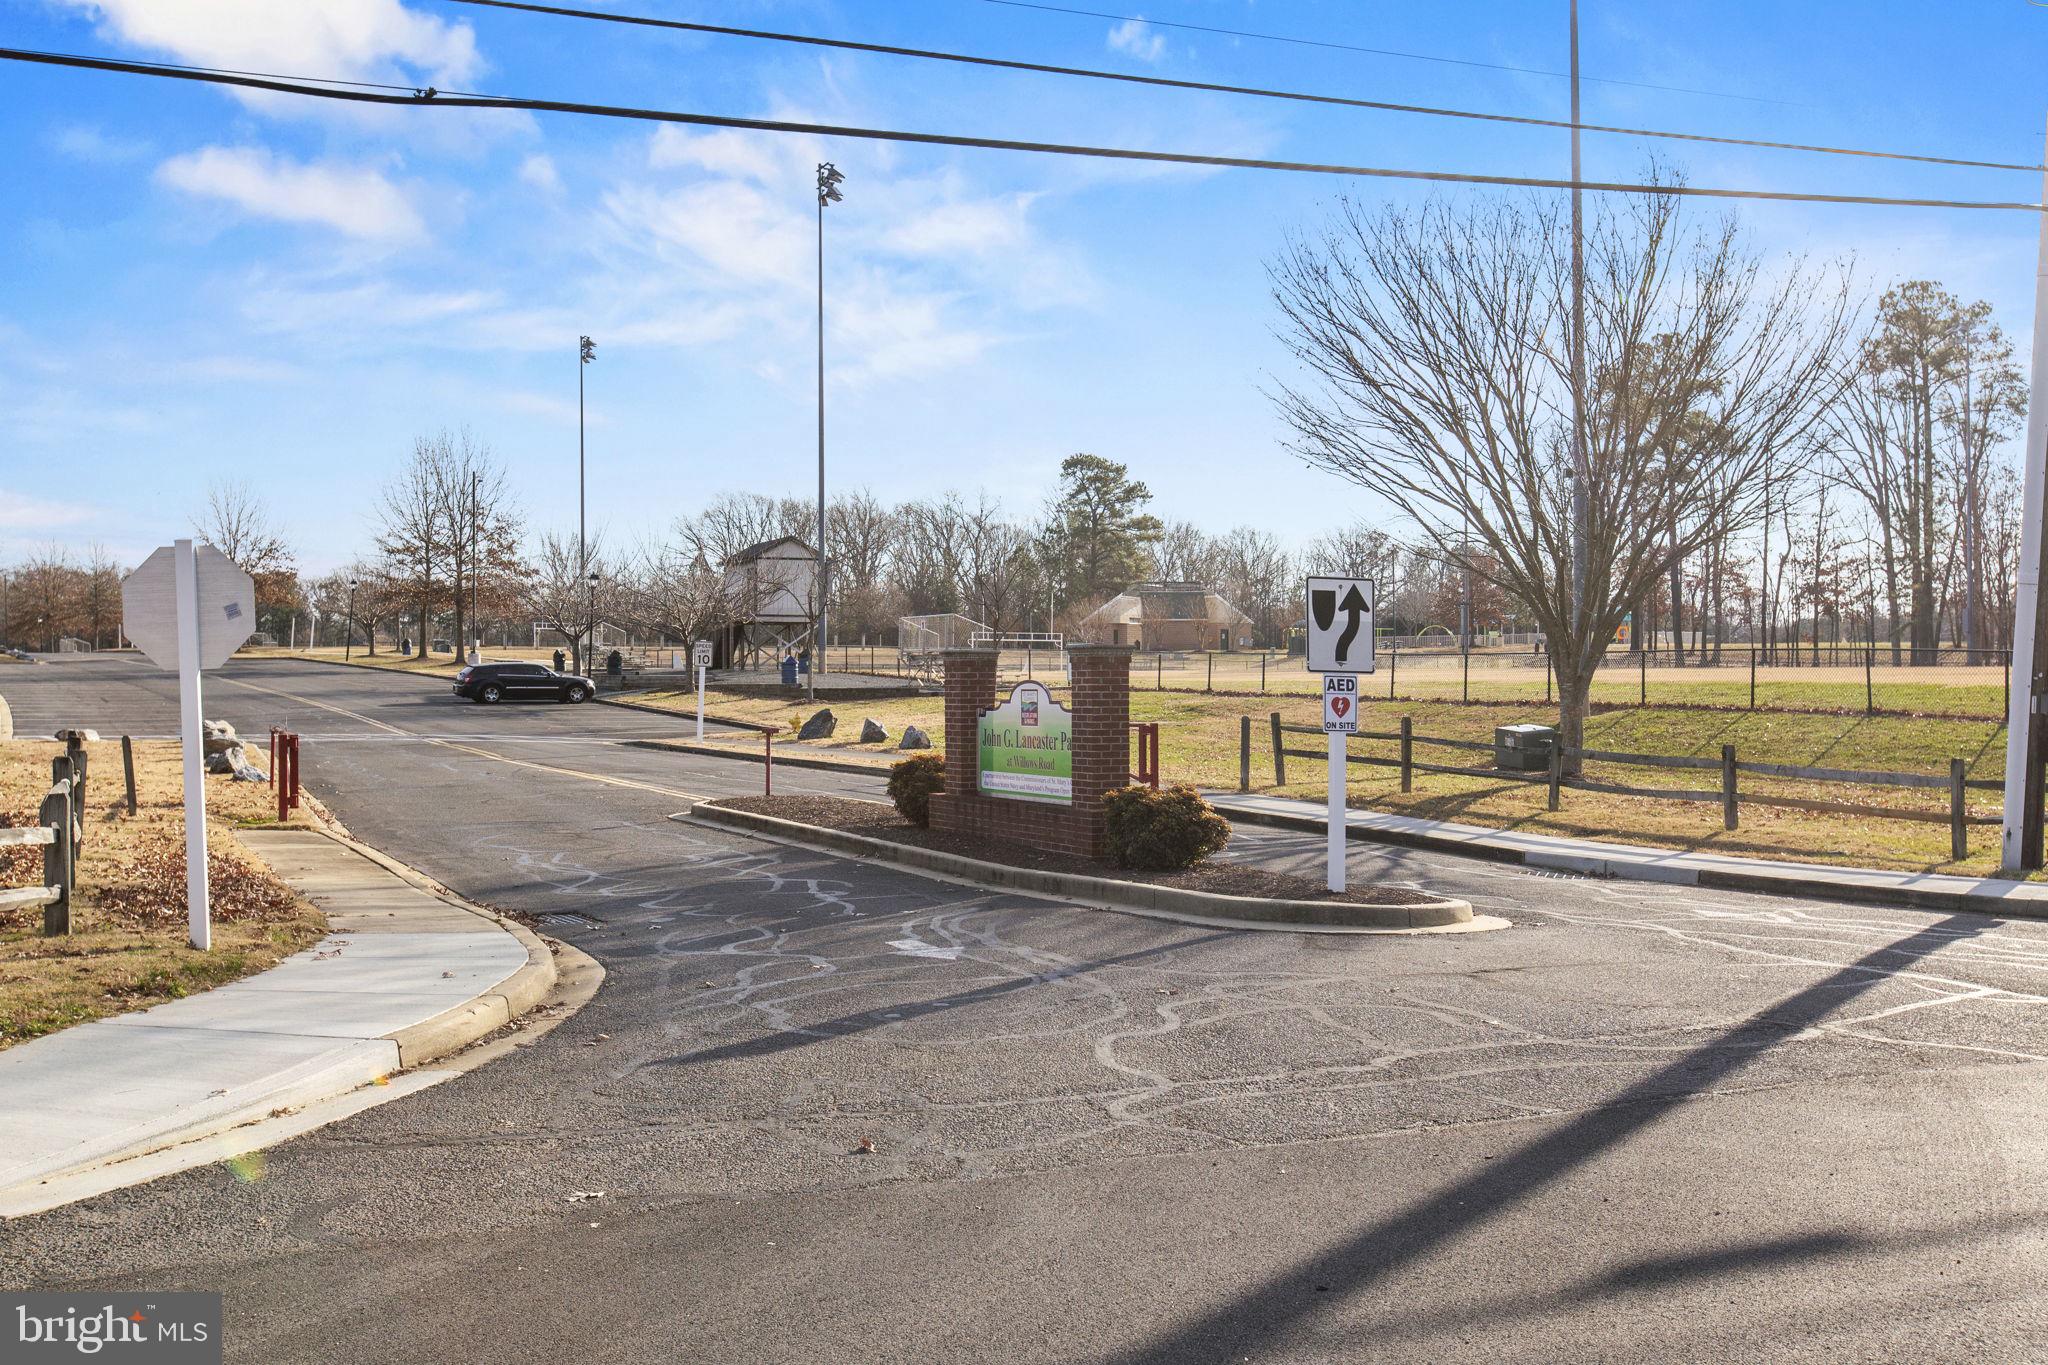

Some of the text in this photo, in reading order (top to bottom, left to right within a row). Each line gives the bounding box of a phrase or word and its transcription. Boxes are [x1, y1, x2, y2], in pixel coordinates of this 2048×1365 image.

[698, 655, 710, 664] 10
[1327, 678, 1354, 691] AED
[1339, 722, 1355, 730] SITE
[983, 728, 1001, 747] John
[1004, 729, 1013, 748] G.
[1016, 730, 1058, 751] Lancaster
[1006, 755, 1056, 771] at Willows Road
